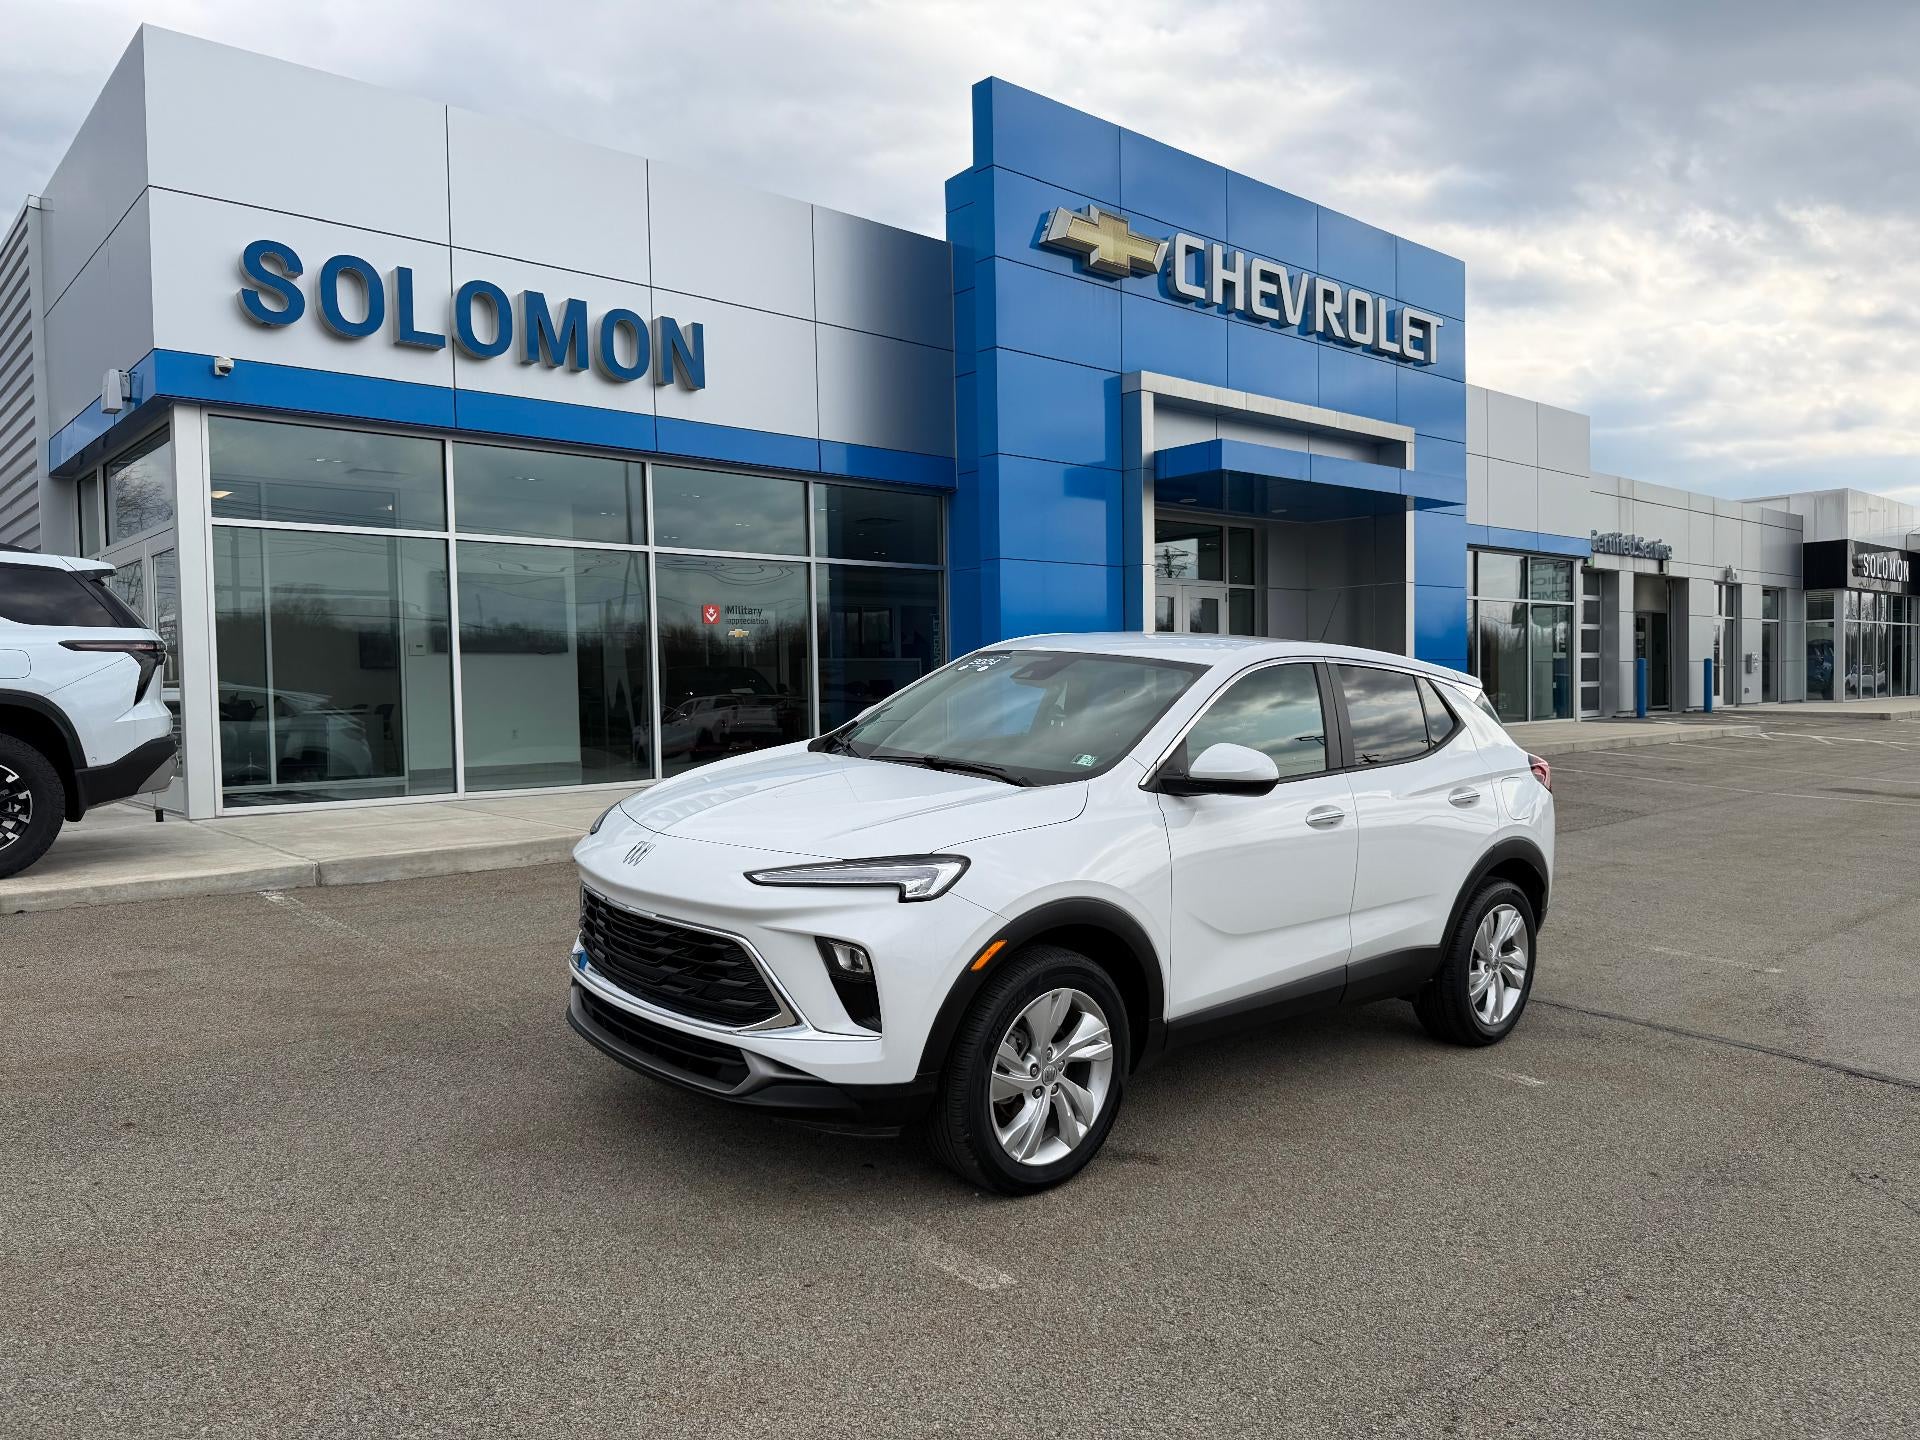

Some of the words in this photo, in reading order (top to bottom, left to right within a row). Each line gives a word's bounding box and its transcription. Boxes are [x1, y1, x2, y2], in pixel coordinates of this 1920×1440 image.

[1171, 231, 1444, 365] CHEVROLET
[238, 239, 705, 391] SOLOMON
[1591, 529, 1635, 555] Certified
[1636, 537, 1673, 560] Service
[1862, 552, 1909, 582] SOLOMON
[725, 604, 763, 617] Military
[726, 617, 769, 626] appreciation
